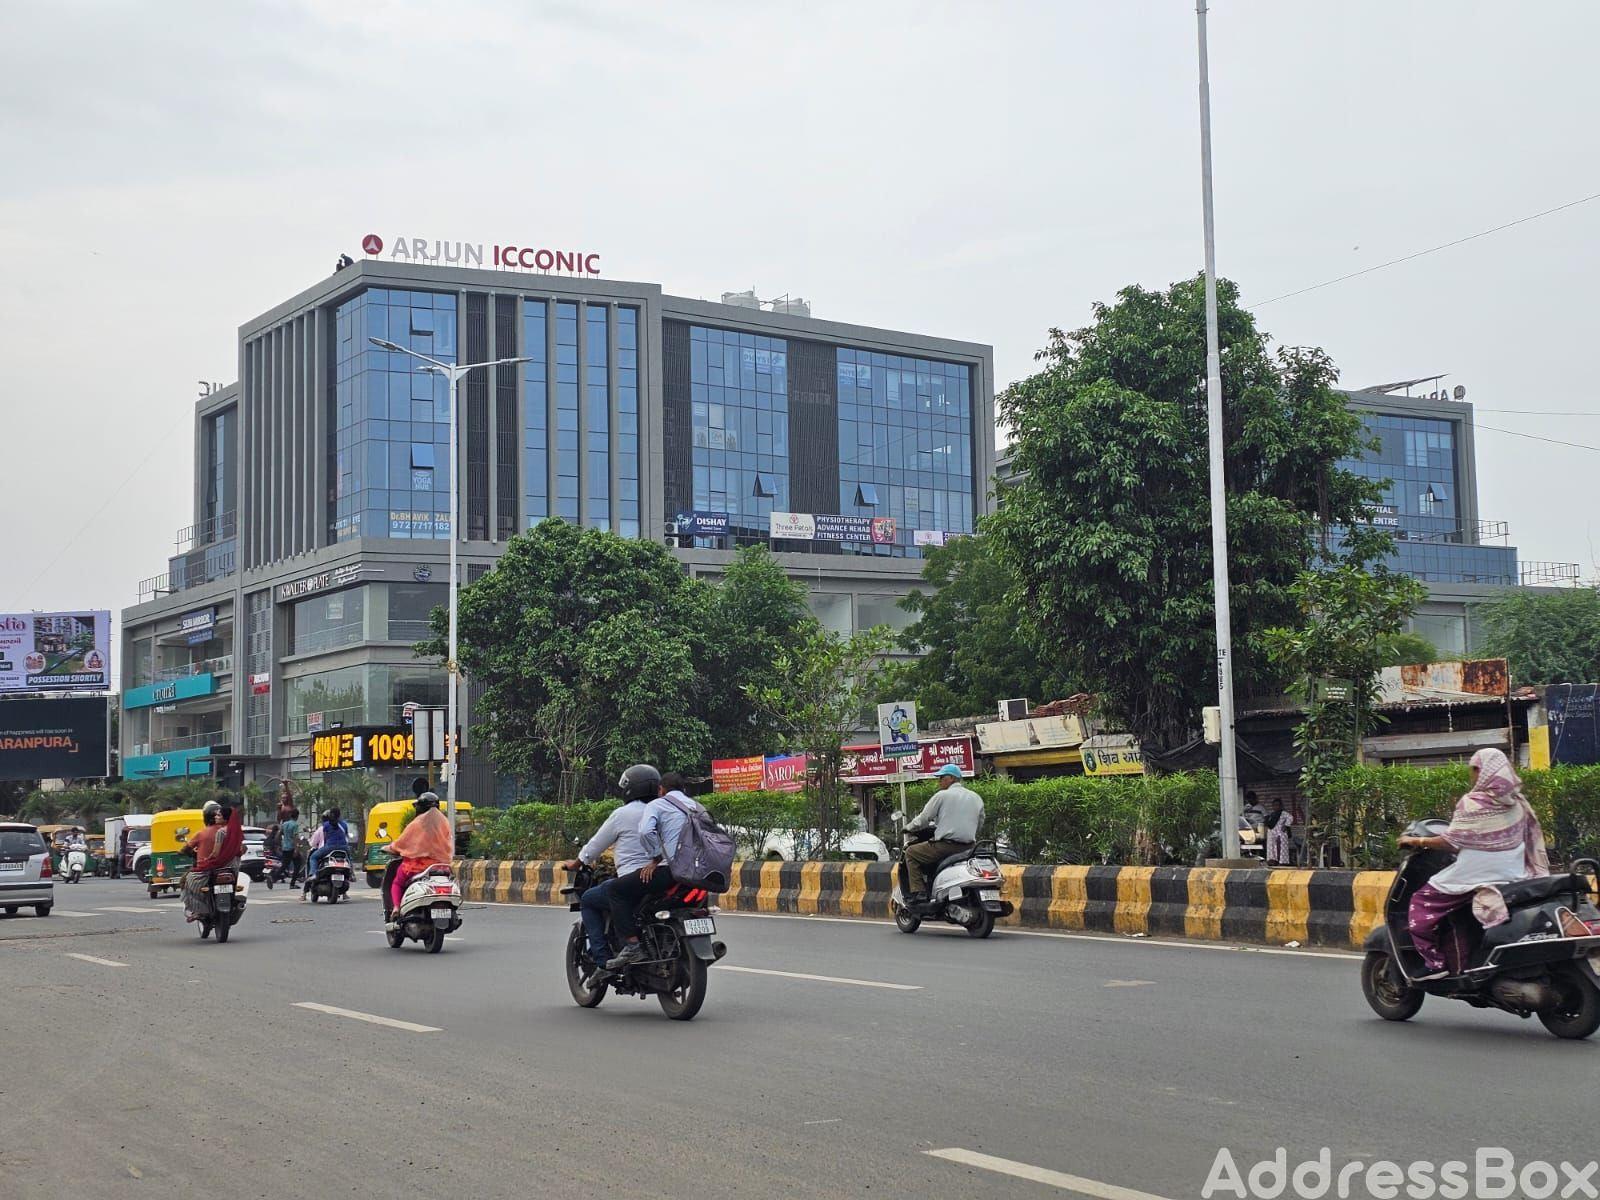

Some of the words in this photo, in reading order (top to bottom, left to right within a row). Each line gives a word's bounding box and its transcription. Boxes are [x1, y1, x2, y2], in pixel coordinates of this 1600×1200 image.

[391, 237, 483, 264] ARJUN
[494, 245, 600, 274] ICCONIC
[696, 517, 727, 526] DISHAY
[817, 516, 871, 525] PHYSIOTHERAPY
[1373, 518, 1399, 526] ENTRE
[776, 523, 794, 531] Three
[817, 524, 848, 532] ADVANCE
[849, 525, 871, 533] REHAB
[846, 533, 871, 541] CENTER
[28, 674, 70, 684] POSSESSION
[70, 673, 102, 683] SHORTLY
